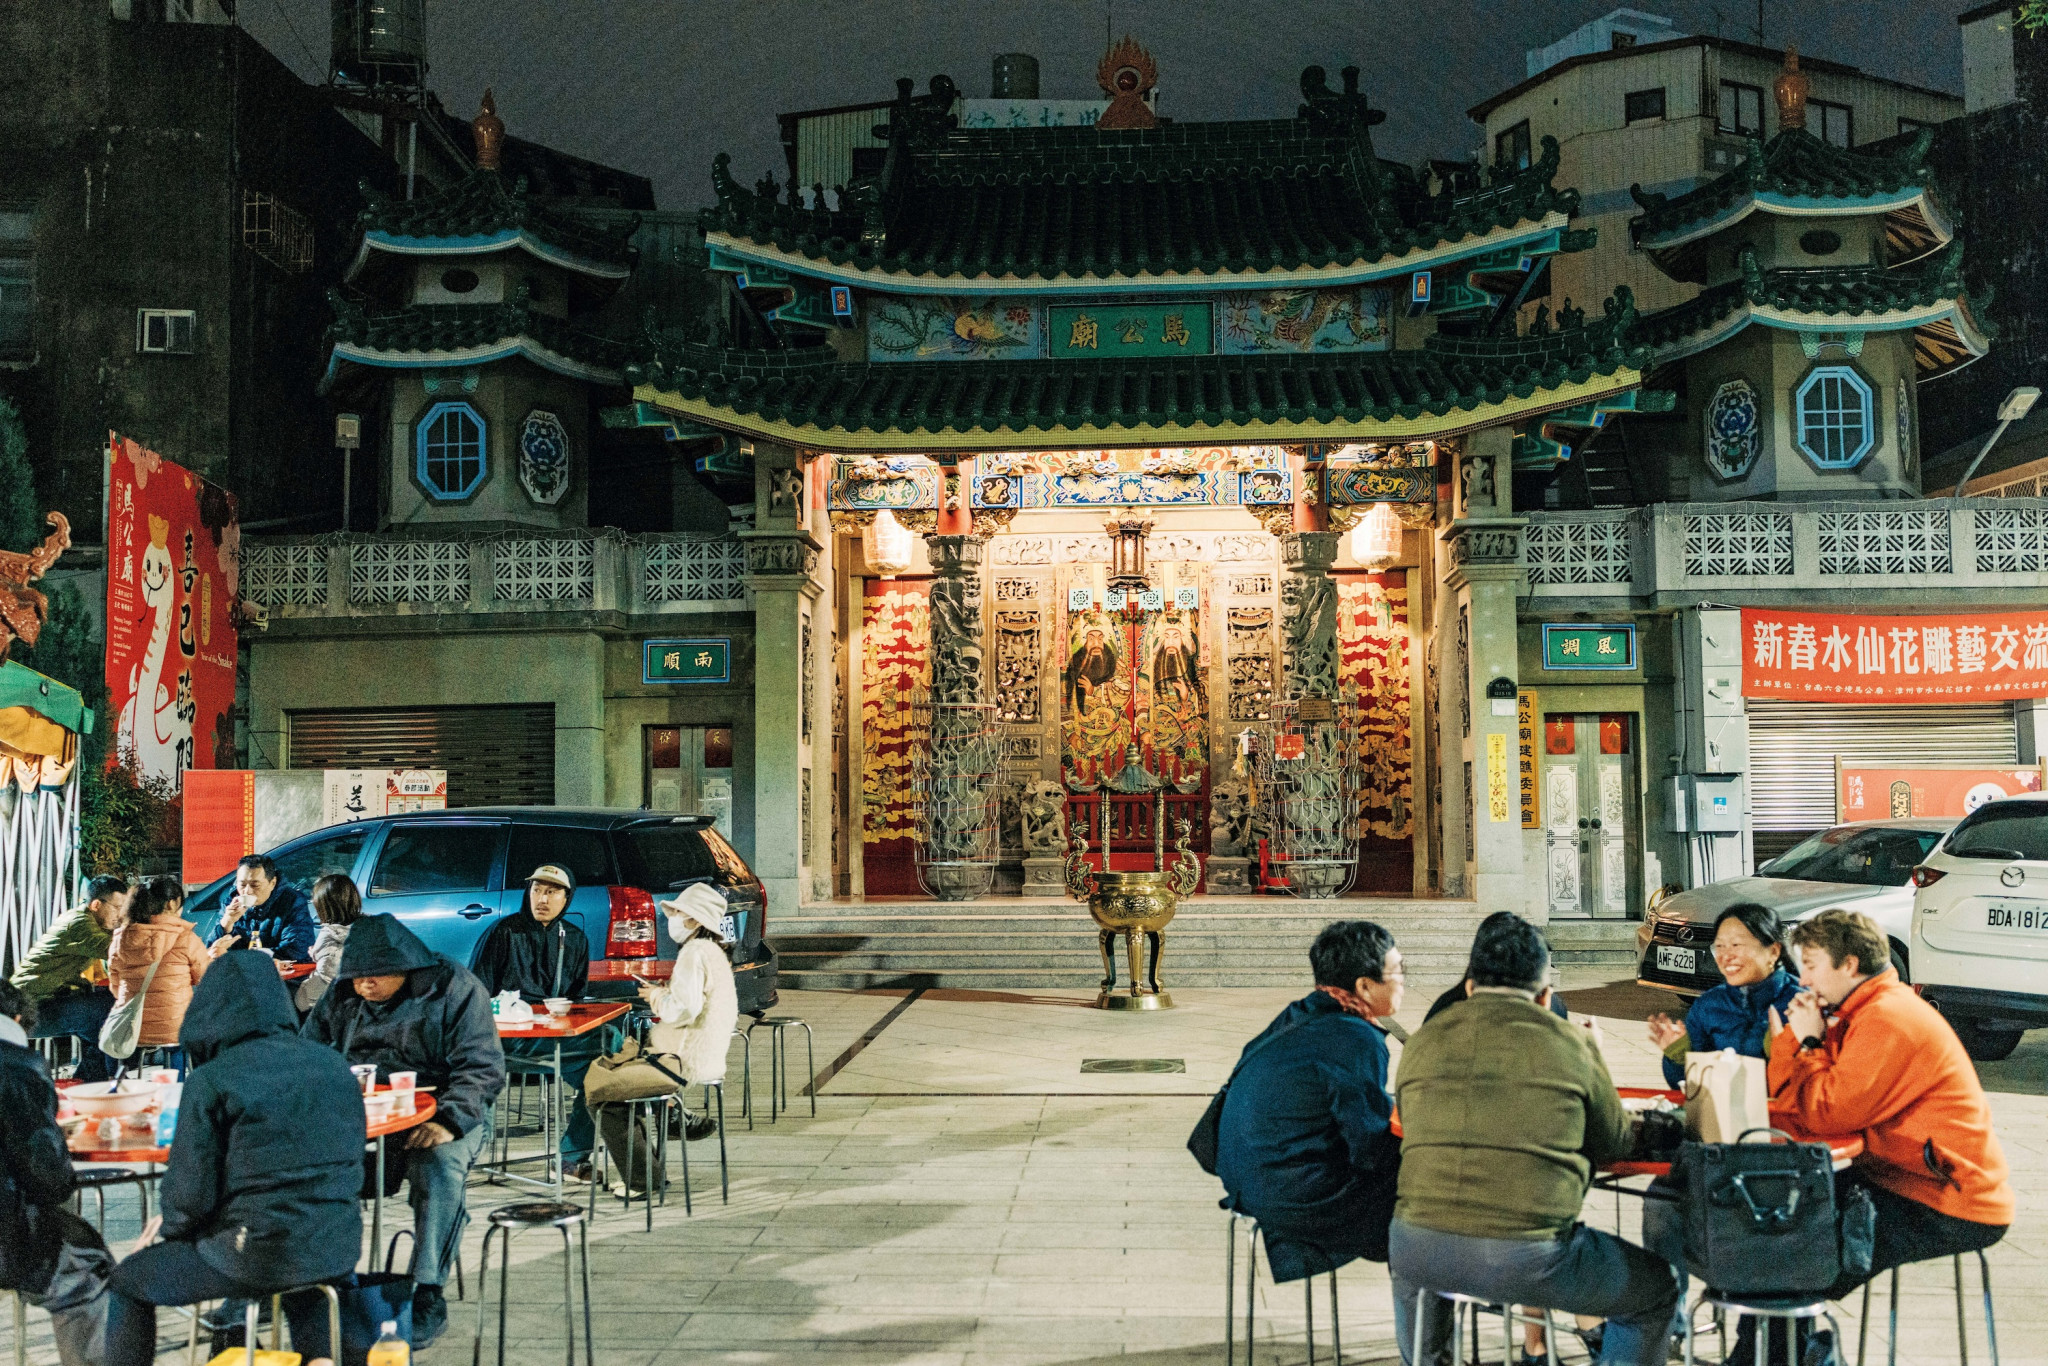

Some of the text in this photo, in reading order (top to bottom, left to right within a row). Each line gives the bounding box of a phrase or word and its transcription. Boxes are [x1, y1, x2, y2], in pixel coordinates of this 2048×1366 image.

[1068, 313, 1191, 351] 馬公廟
[118, 483, 134, 585] 馬公廟
[1752, 620, 2048, 675] 新春水仙花雕藝交流
